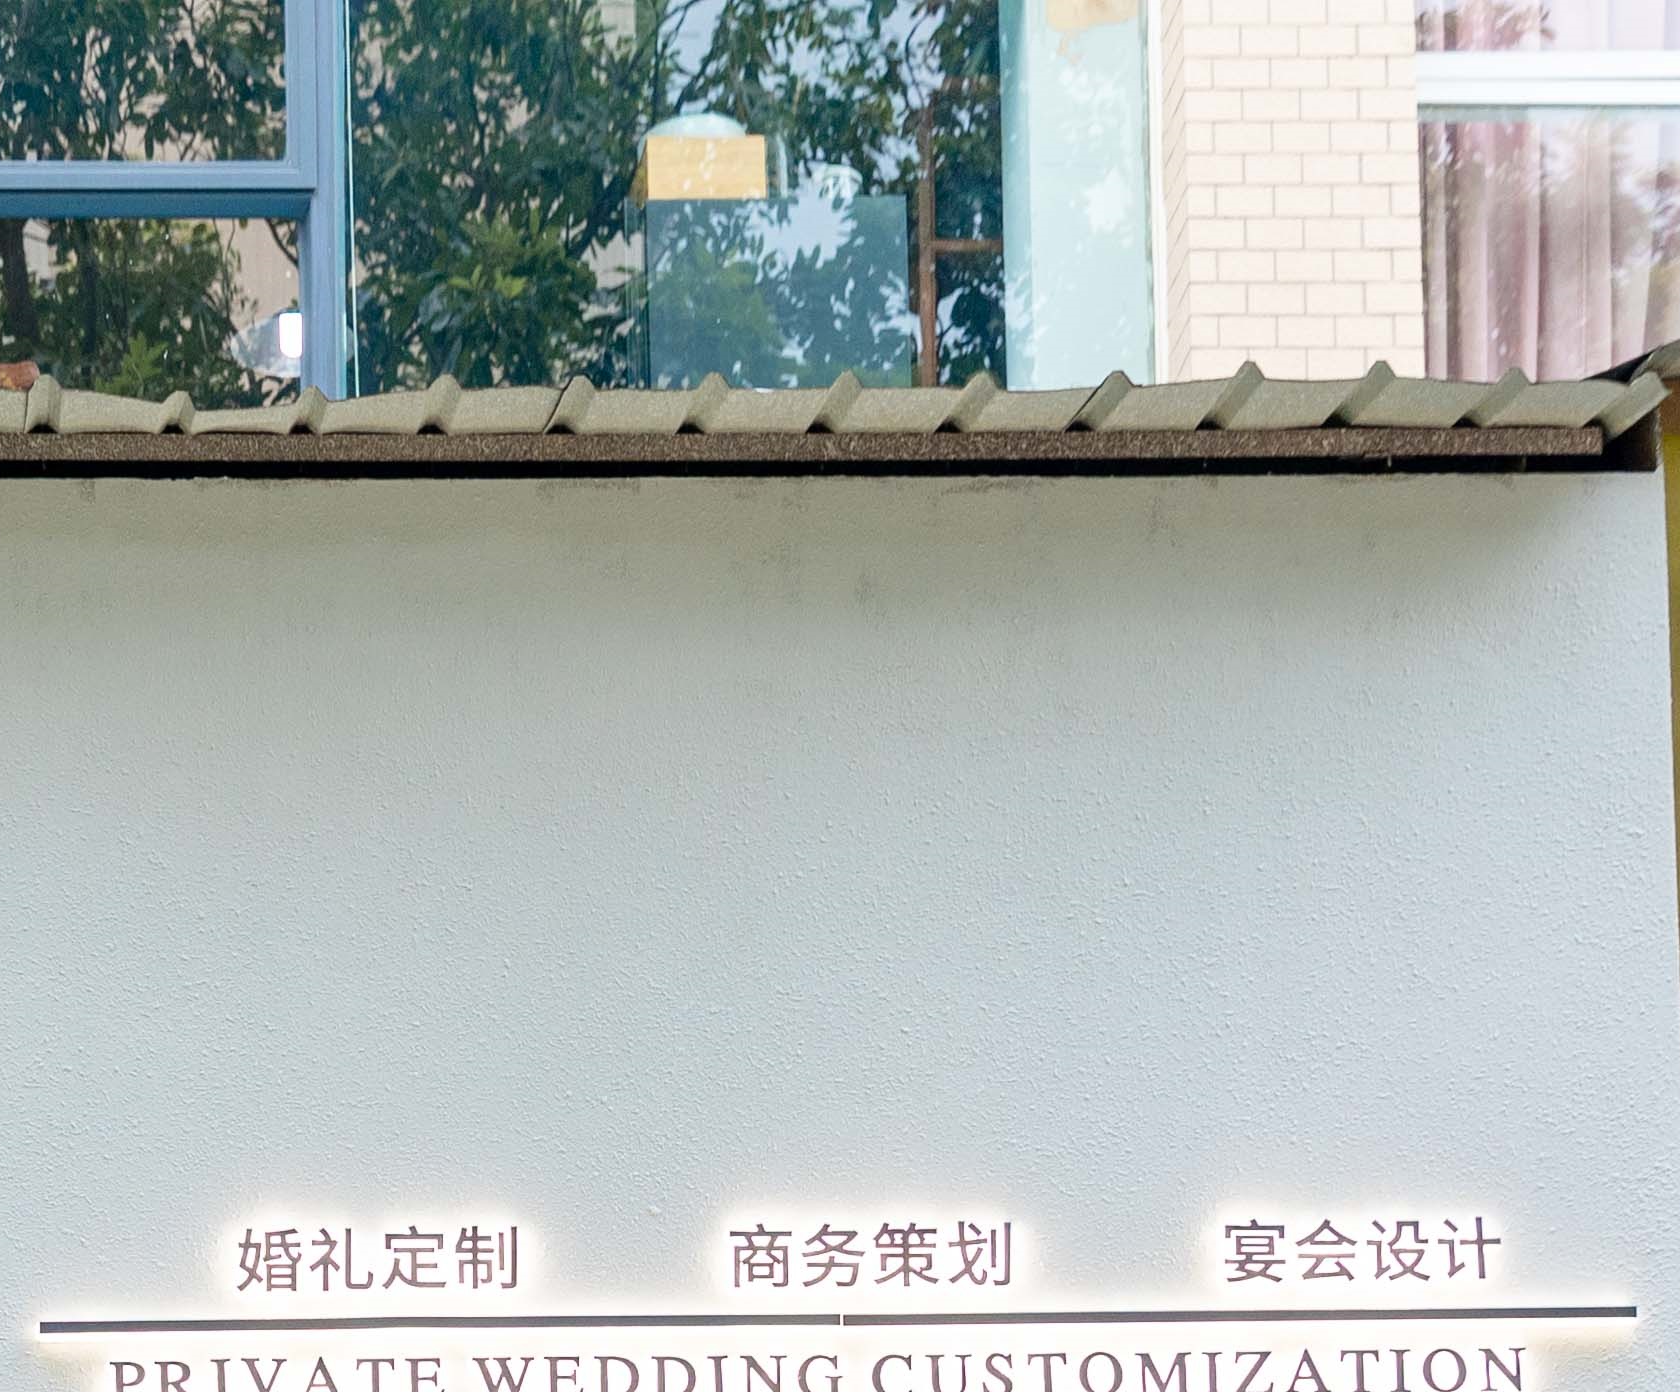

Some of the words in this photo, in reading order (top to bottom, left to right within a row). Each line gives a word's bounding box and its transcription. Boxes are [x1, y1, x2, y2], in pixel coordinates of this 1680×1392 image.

[236, 1224, 521, 1293] 婚礼定制
[727, 1220, 1014, 1289] 商务策划
[1223, 1216, 1505, 1286] 宴会设计
